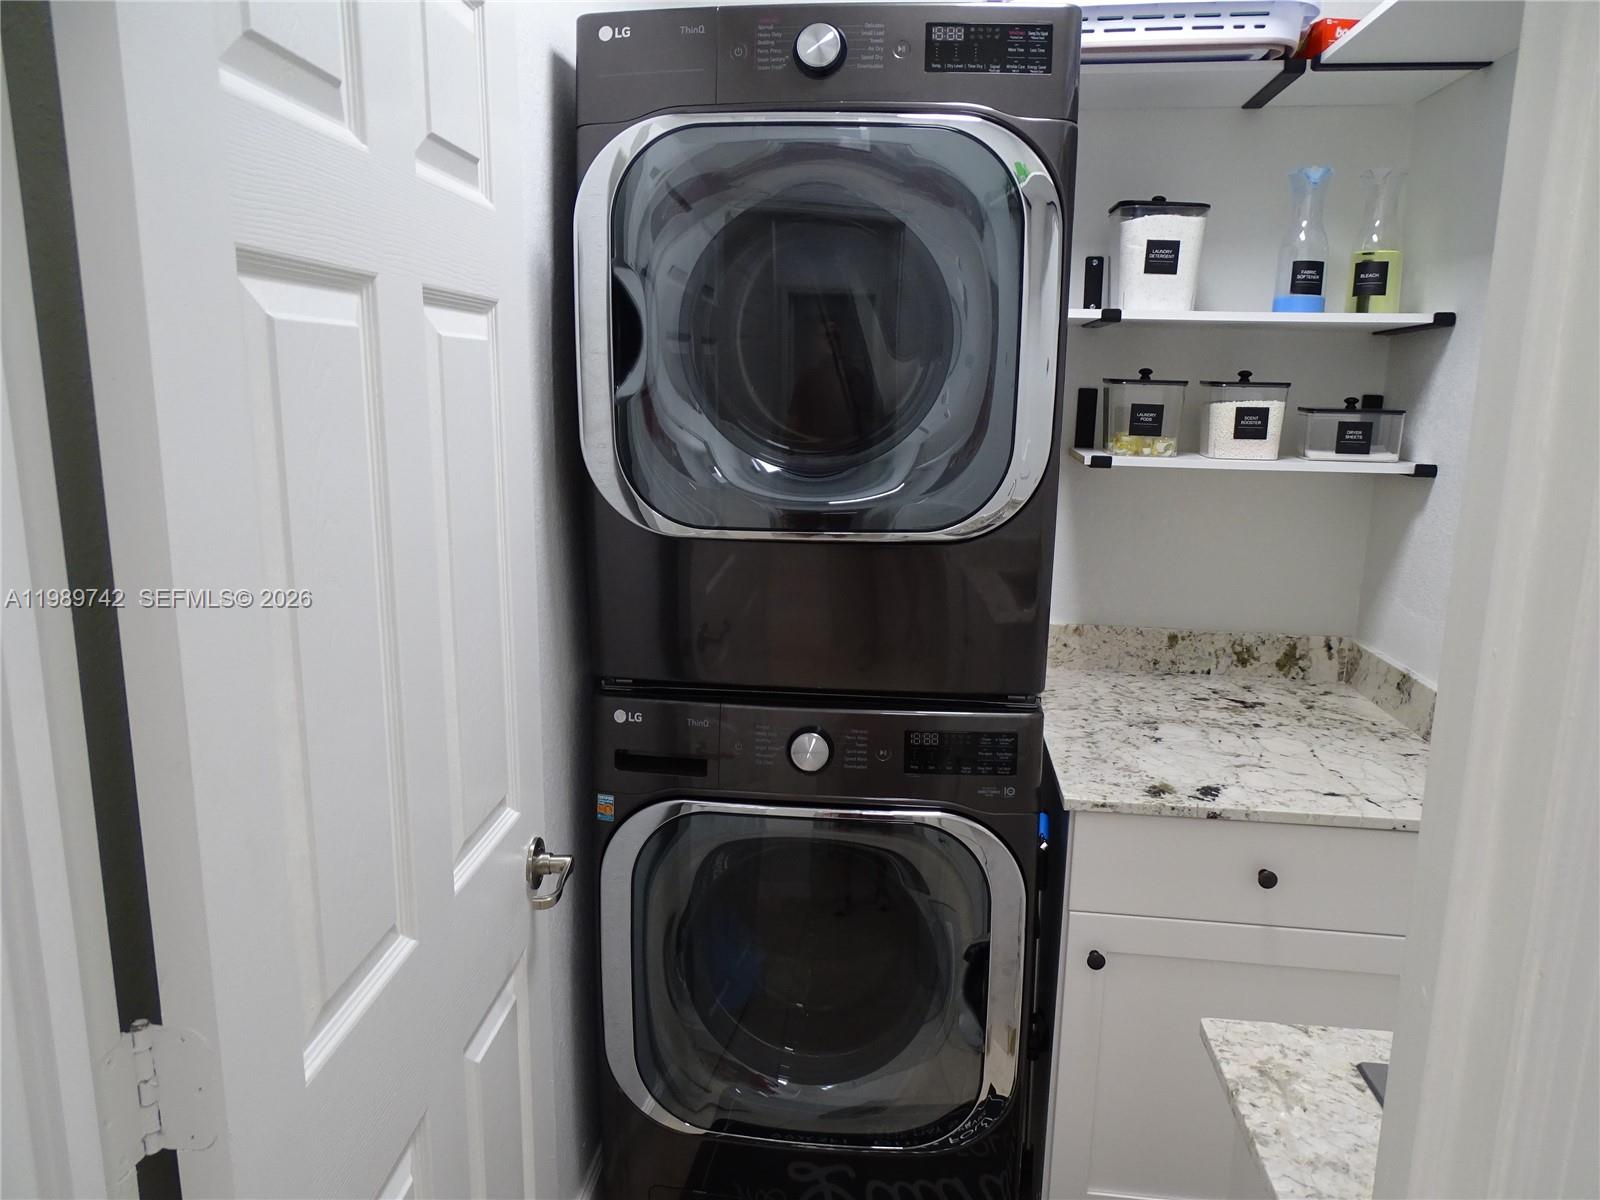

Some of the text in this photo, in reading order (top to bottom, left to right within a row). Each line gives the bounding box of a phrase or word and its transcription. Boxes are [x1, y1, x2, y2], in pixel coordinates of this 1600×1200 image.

[614, 27, 631, 39] LG
[680, 25, 705, 34] ThinQ
[628, 711, 643, 722] LG
[687, 718, 710, 728] ThinQ
